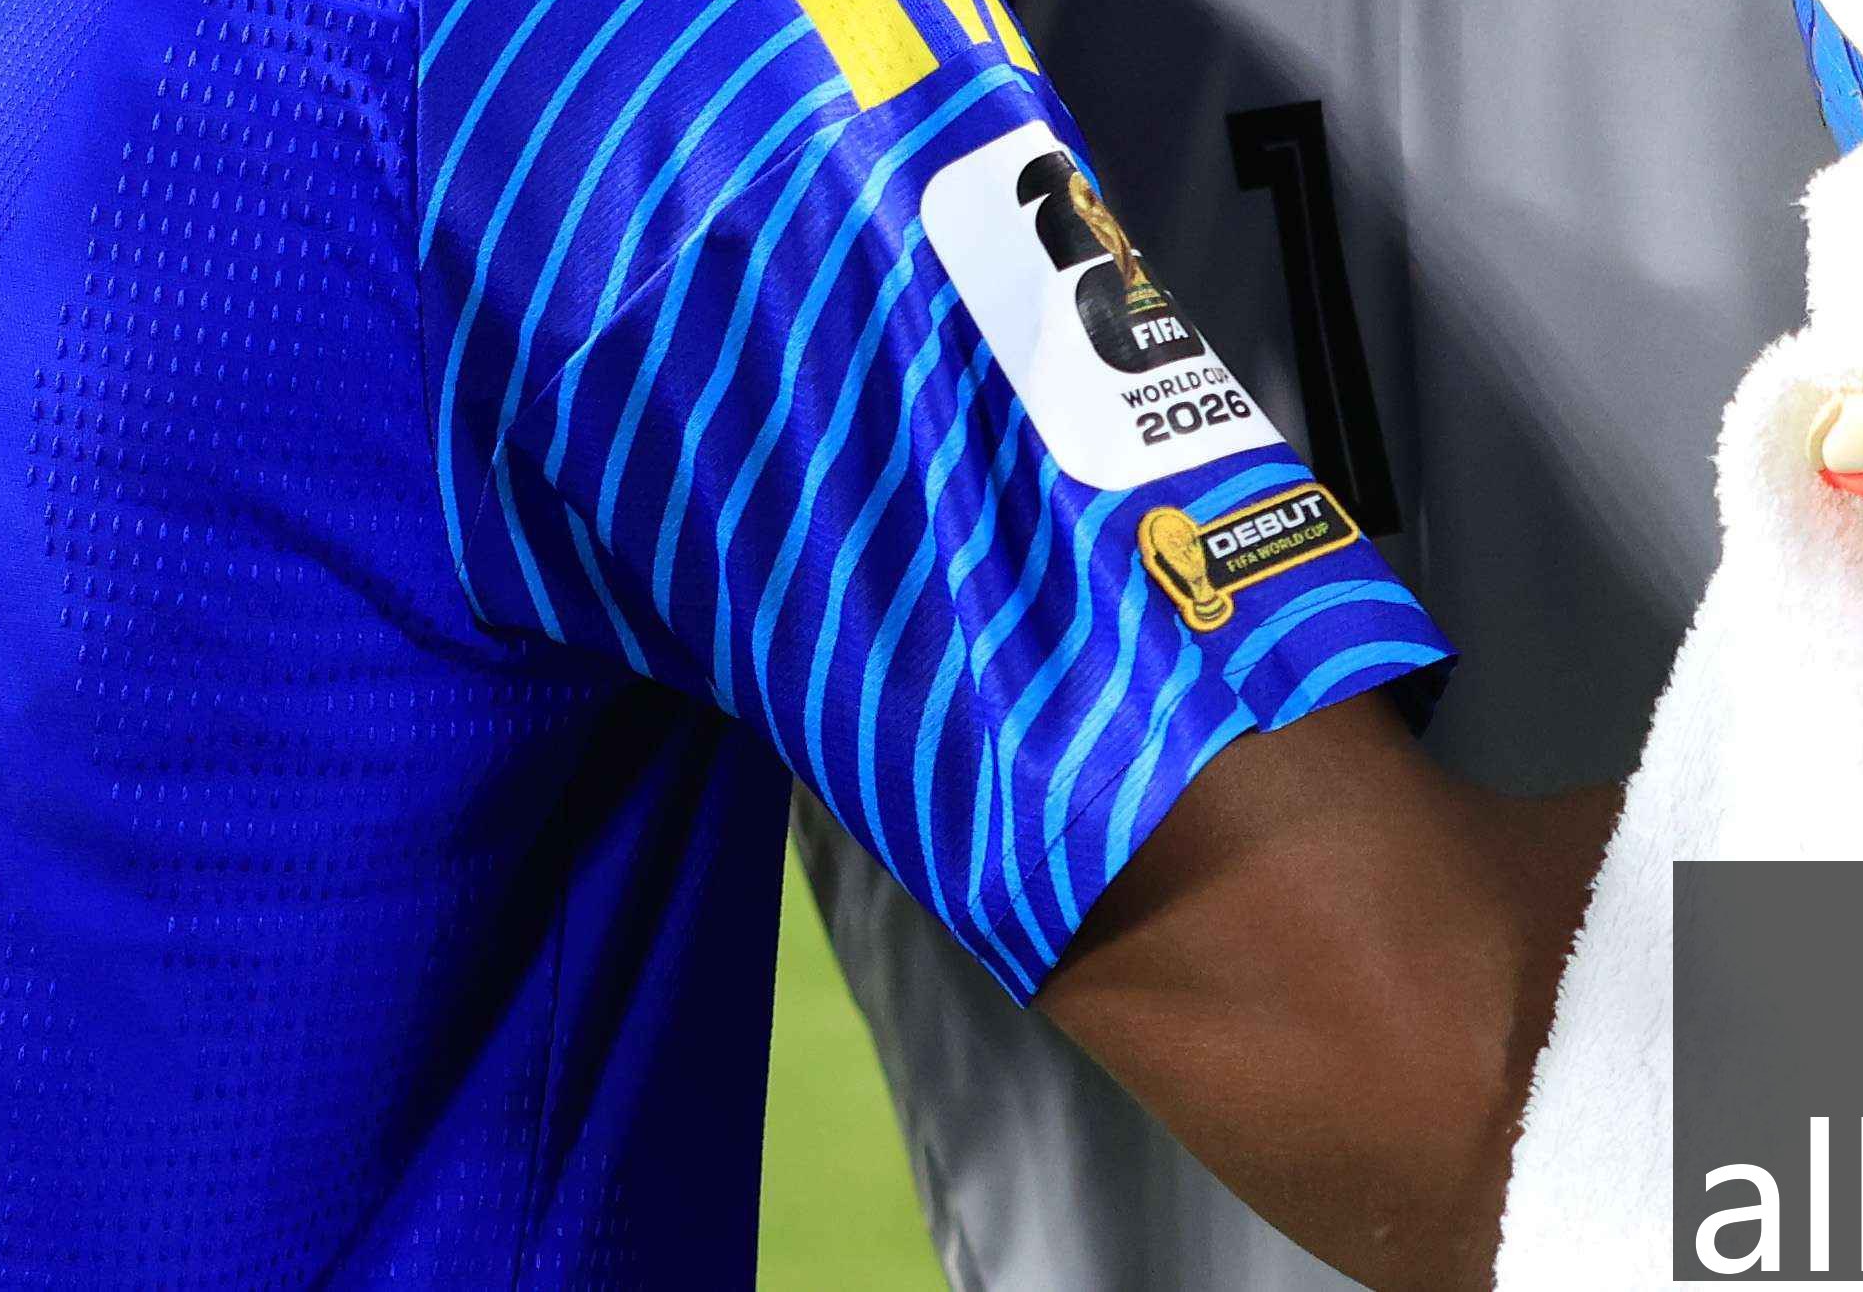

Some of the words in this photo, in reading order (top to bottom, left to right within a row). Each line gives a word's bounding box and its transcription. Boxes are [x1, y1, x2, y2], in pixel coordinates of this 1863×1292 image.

[1131, 316, 1189, 350] FIFA
[1224, 100, 1403, 538] 1
[1121, 371, 1202, 409] WORLD
[1136, 389, 1251, 446] 2026
[1206, 494, 1322, 560] DEBUT
[1226, 551, 1259, 573] FIFA
[1258, 531, 1305, 561] WORLD
[1305, 521, 1330, 541] CUP
